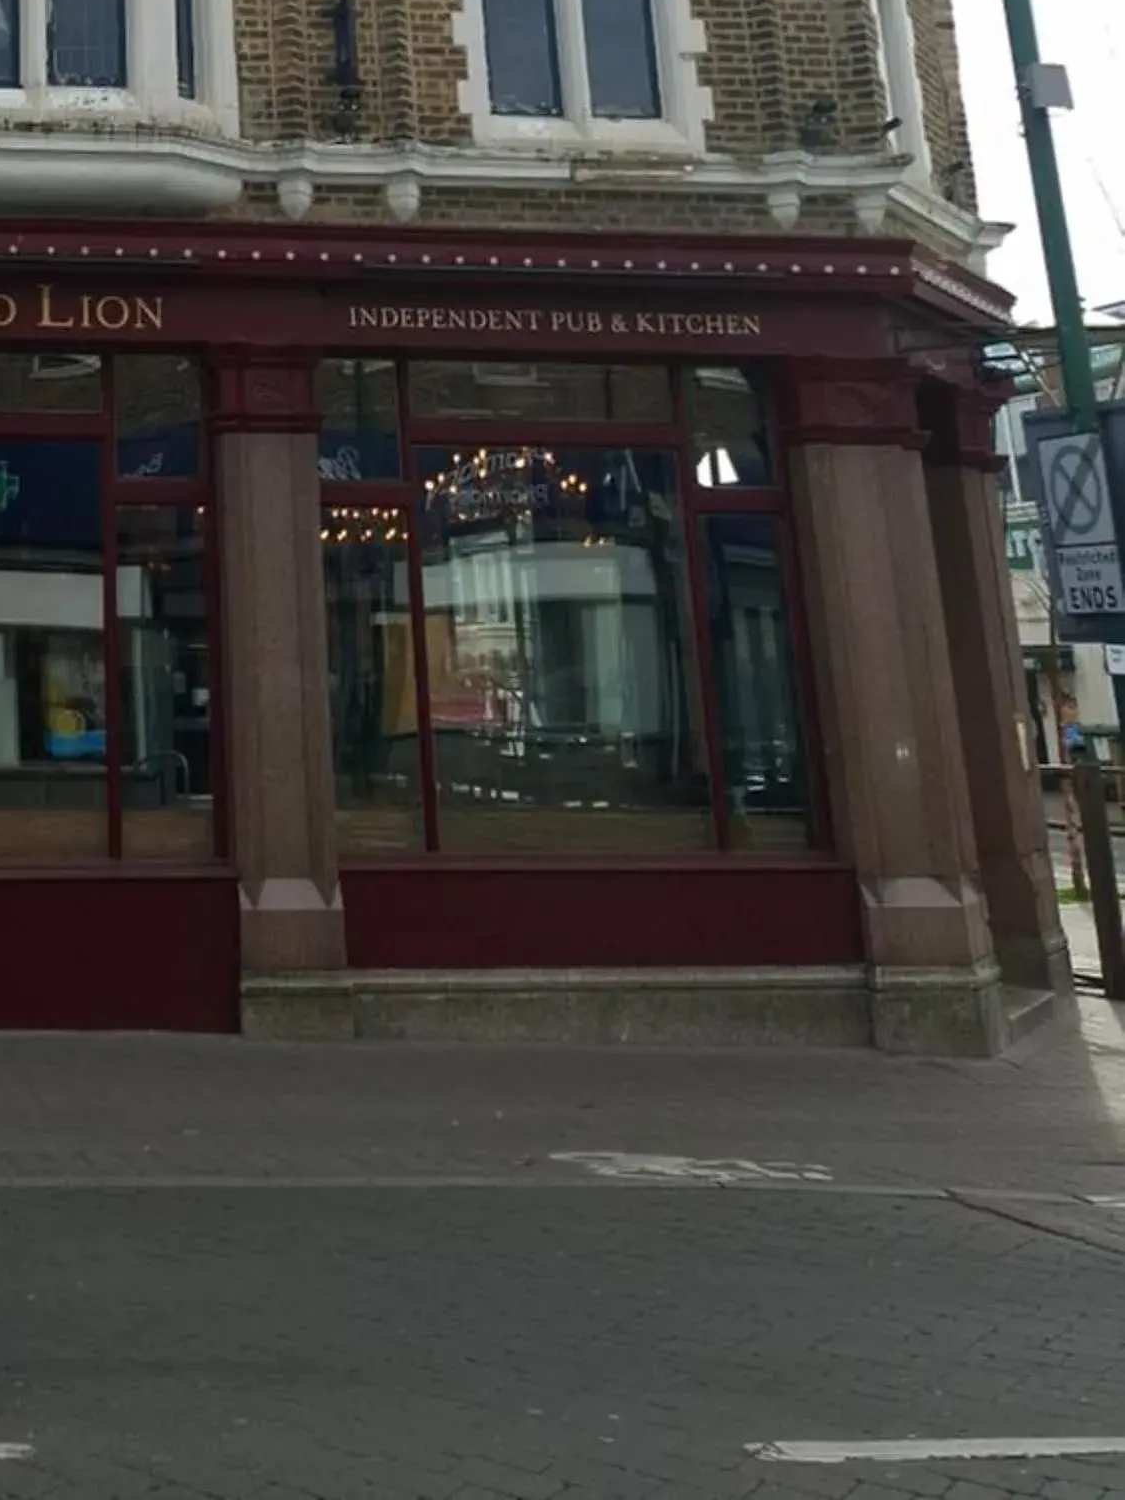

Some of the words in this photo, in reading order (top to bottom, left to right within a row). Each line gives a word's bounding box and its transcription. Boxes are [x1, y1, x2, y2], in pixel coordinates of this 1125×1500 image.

[348, 305, 543, 332] INDEPENDENT
[549, 310, 603, 334] PUB
[610, 311, 630, 334] &
[634, 311, 762, 336] KITCHEN
[1069, 585, 1119, 610] ENDS
